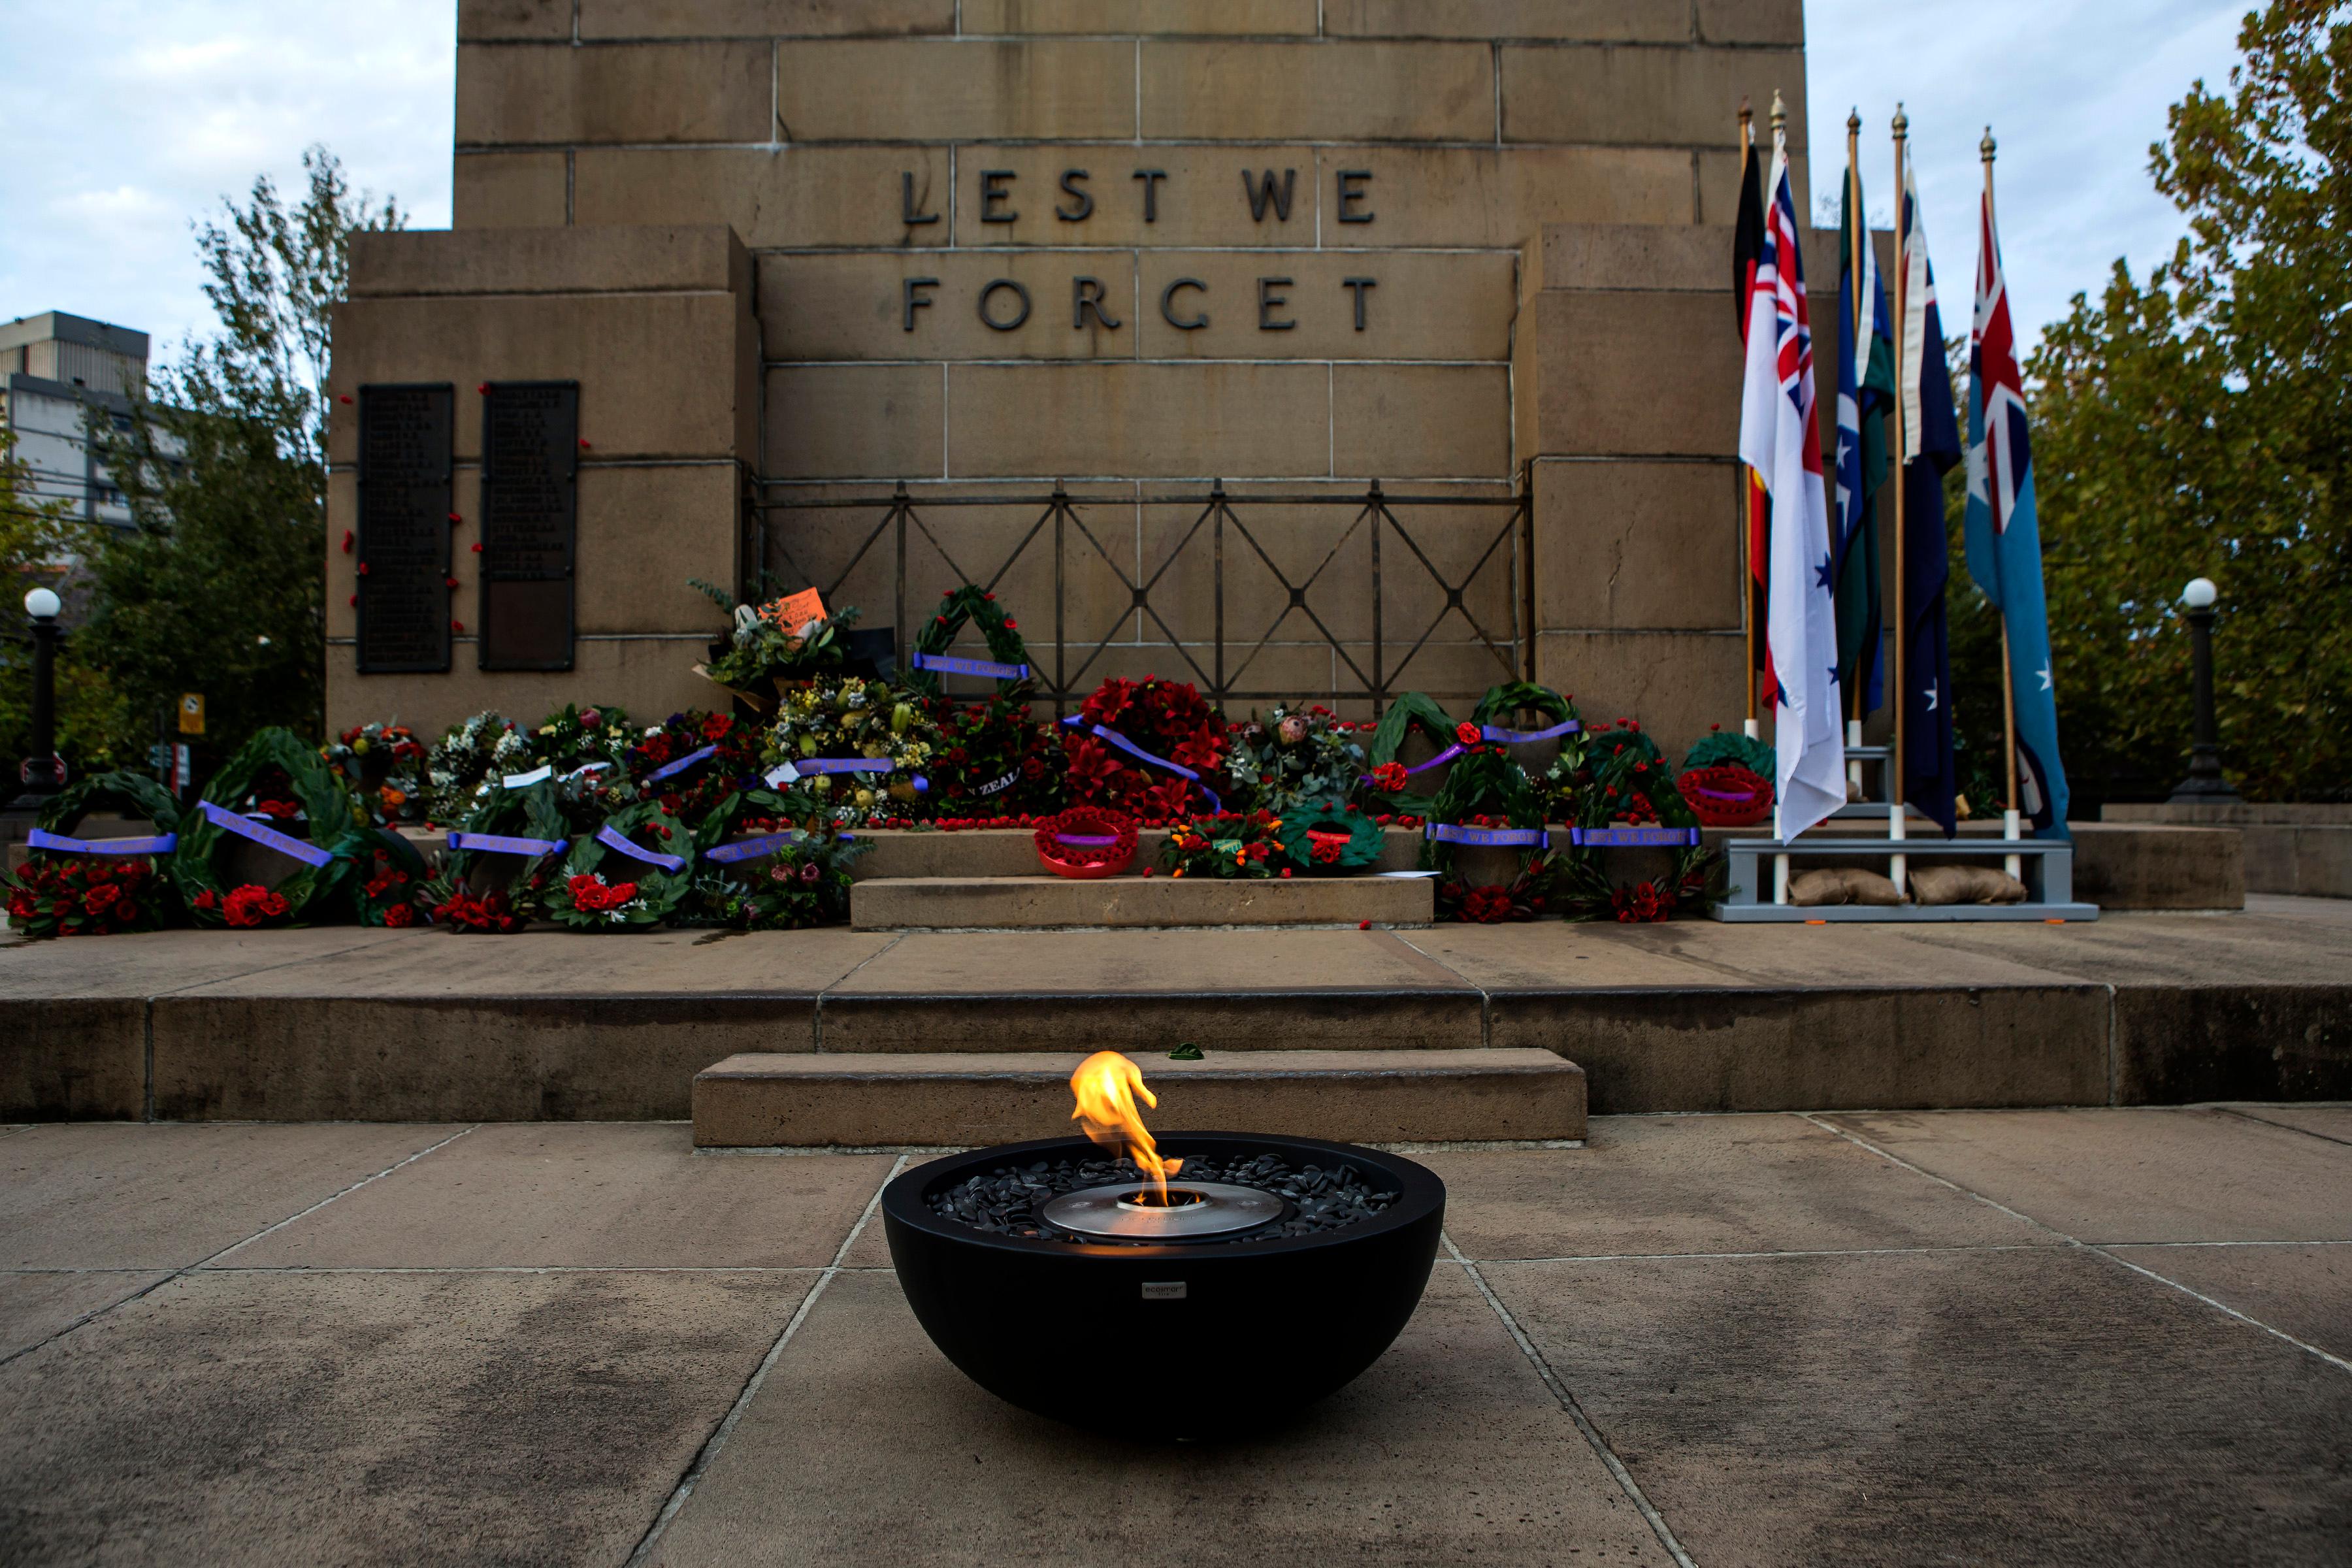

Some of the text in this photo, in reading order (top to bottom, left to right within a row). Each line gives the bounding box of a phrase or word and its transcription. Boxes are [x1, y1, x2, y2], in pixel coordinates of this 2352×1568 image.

[902, 169, 1375, 223] LEST WE
[902, 276, 1377, 331] FORGET
[955, 661, 972, 672] WE
[979, 766, 1021, 796] ZEAL
[1469, 832, 1489, 842] WE
[1616, 832, 1639, 843] WE
[740, 842, 764, 855] WE
